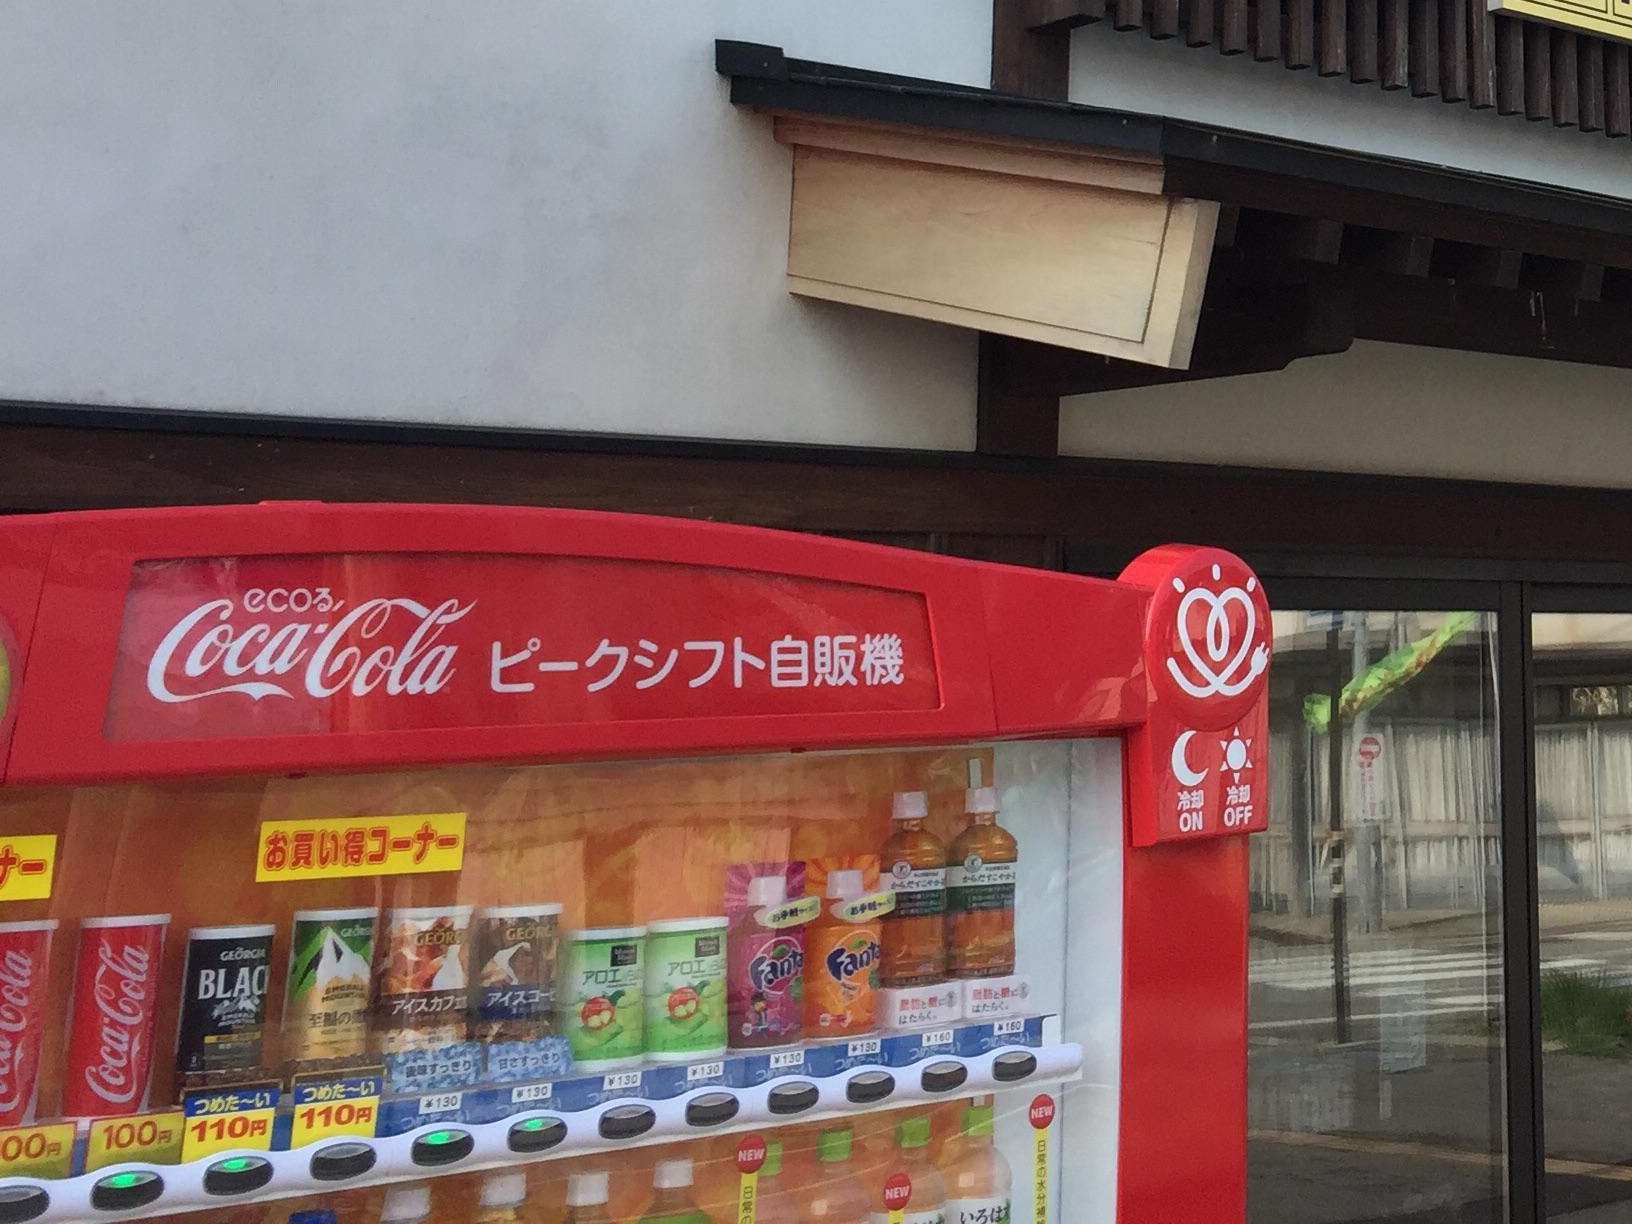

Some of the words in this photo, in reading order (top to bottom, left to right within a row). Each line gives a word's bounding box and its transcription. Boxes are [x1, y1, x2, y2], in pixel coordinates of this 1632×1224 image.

[147, 598, 478, 703] Coca-Cola
[491, 633, 905, 693] ピークシフト自販機
[1177, 789, 1205, 811] 冷却
[1226, 784, 1251, 806] 冷却
[1179, 811, 1203, 832] ON
[1224, 805, 1254, 827] OFF
[263, 822, 460, 871] お買い得コーナー
[85, 938, 149, 1104] Coca-Cola
[300, 1104, 373, 1130] 110円
[1031, 1104, 1053, 1119] NEW
[104, 1120, 173, 1151] 100円
[191, 1115, 269, 1143] 110円
[738, 1147, 765, 1162] NEW
[885, 1185, 910, 1200] NEW
